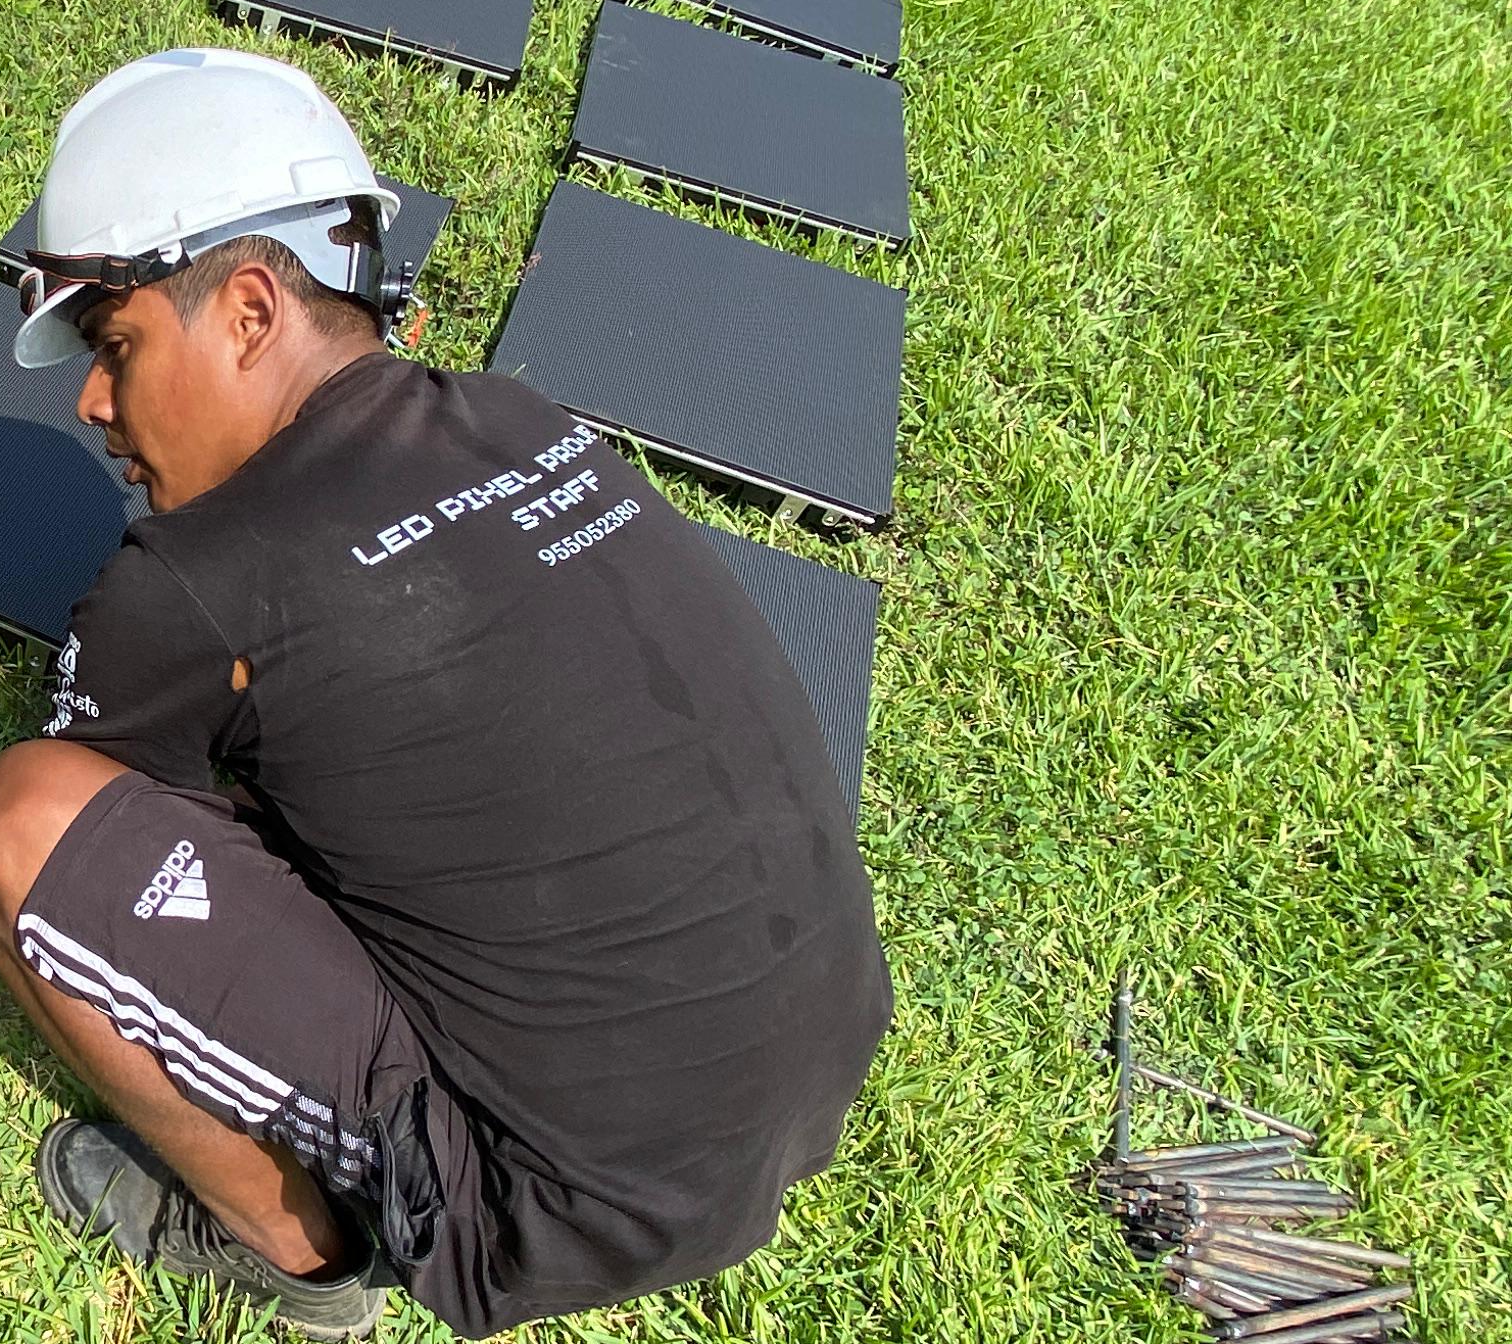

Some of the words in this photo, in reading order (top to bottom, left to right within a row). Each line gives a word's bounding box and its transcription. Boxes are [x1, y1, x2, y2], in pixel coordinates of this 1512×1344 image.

[351, 513, 436, 566] LED
[434, 469, 543, 522] PIXEL
[510, 468, 600, 531] STAFF
[537, 497, 642, 568] 955052380
[133, 839, 196, 920] adidas
